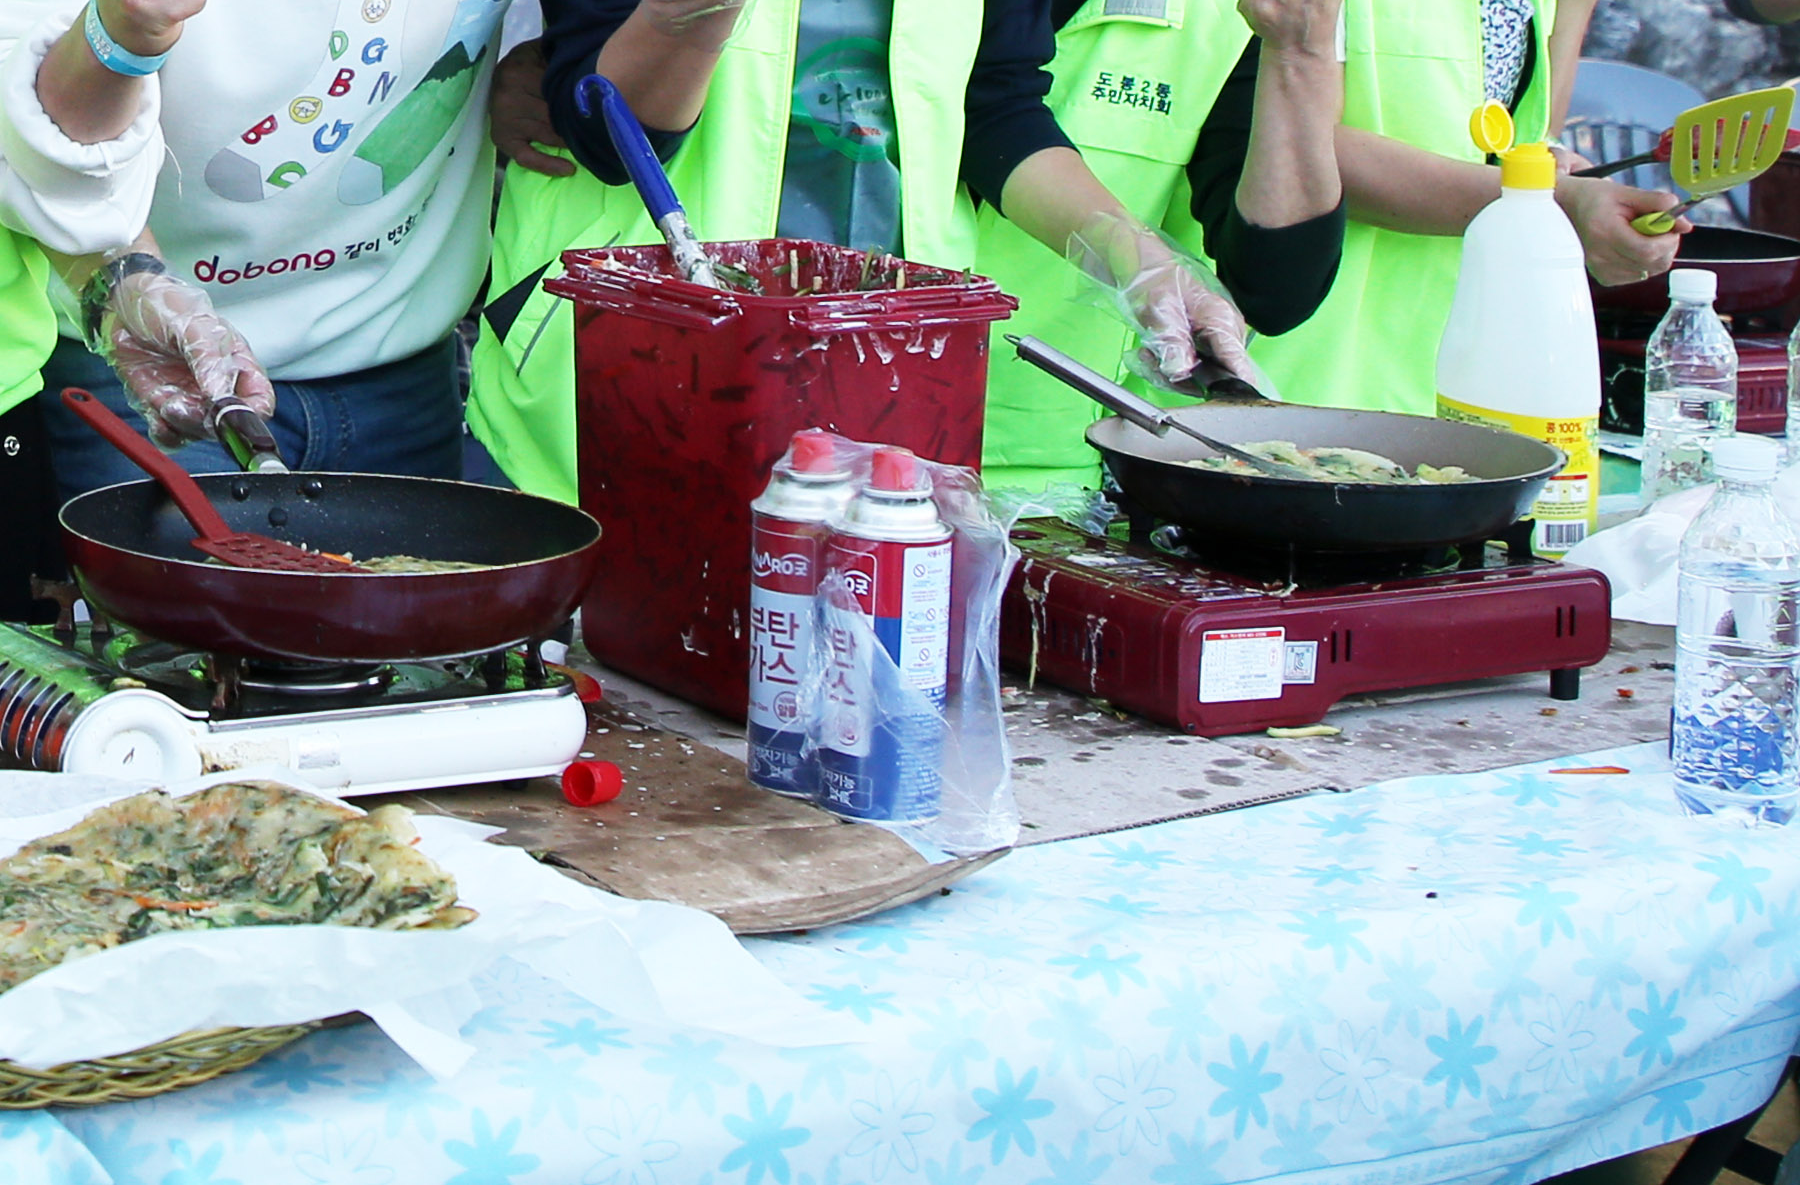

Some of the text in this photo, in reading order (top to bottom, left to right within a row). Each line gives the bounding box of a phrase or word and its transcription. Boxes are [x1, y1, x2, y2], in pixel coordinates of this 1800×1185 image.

[360, 36, 389, 65] G
[326, 67, 398, 105] B N
[1090, 85, 1173, 116] 주민자치회
[240, 114, 279, 145] B
[193, 248, 337, 285] dobong
[344, 237, 381, 261] 같이
